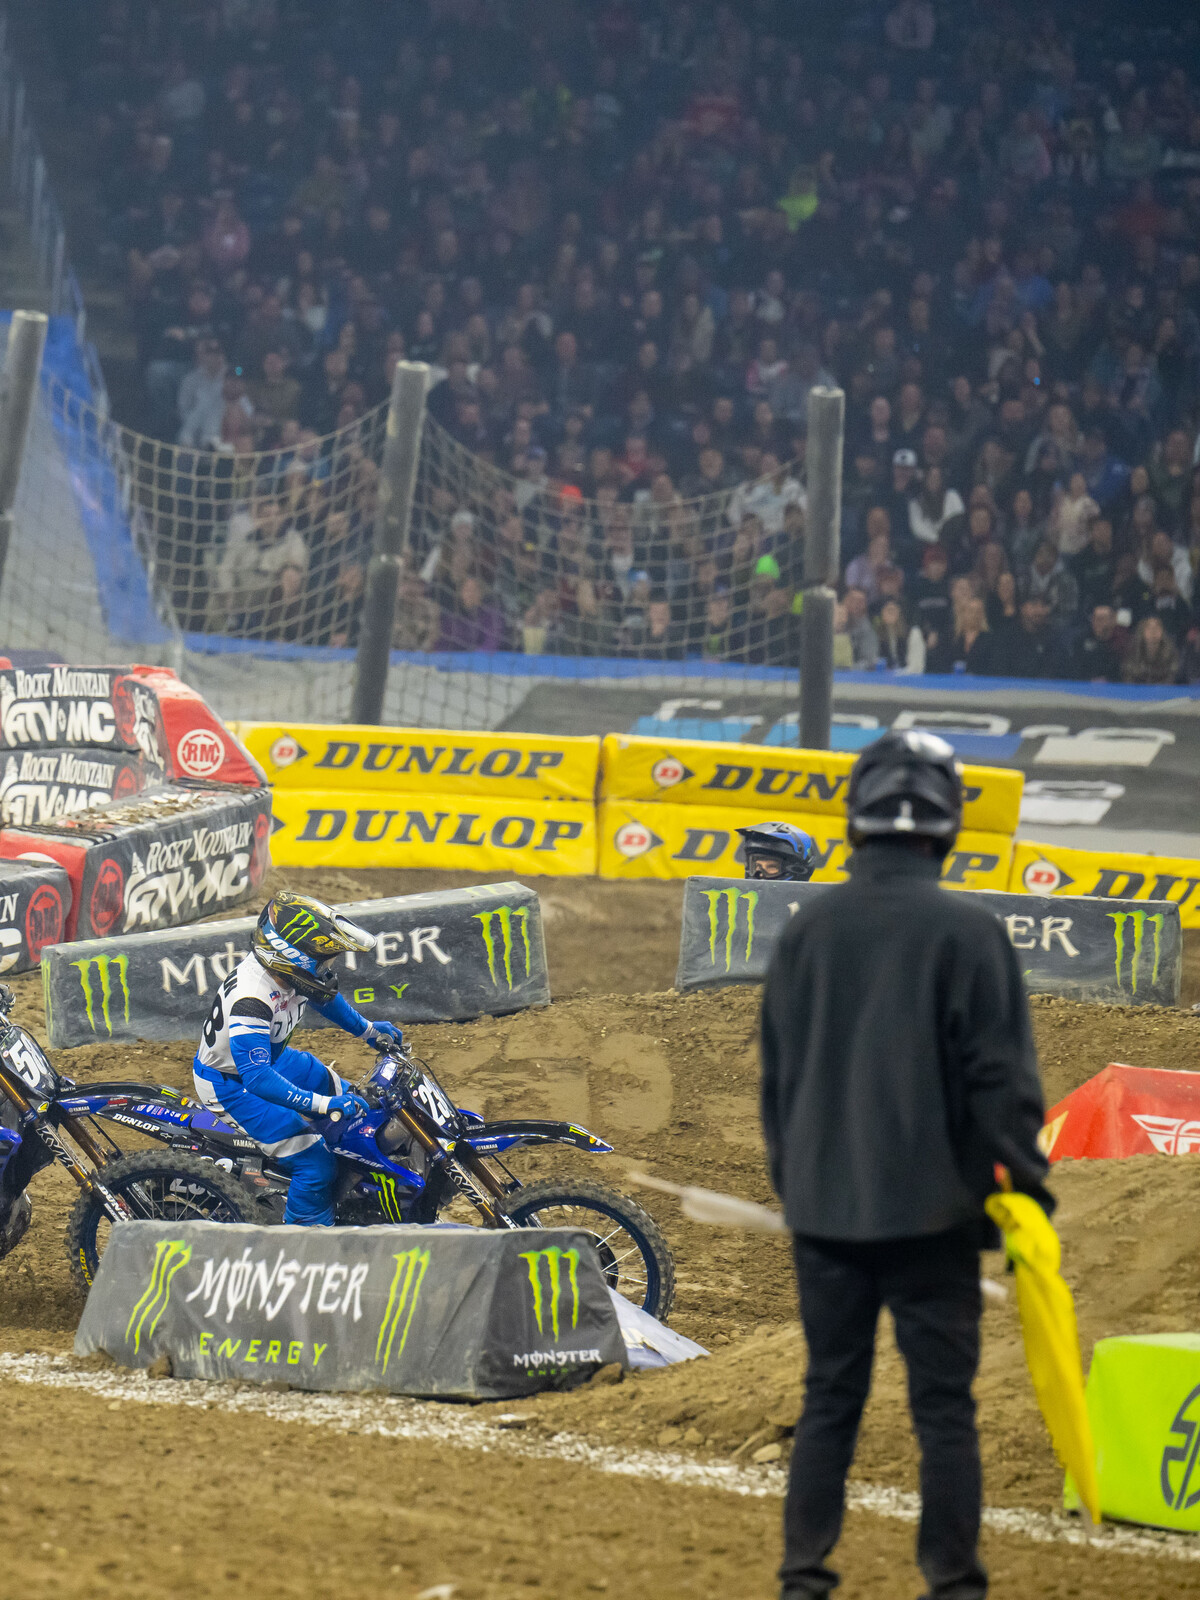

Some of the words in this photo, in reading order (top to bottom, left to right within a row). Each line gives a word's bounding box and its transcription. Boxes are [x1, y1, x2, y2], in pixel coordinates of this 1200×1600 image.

[16, 669, 50, 699] ROCKY
[52, 667, 110, 697] MOUNTAIN
[19, 752, 56, 781] ROCKY
[57, 753, 115, 788] MOUNTAIN
[188, 743, 215, 762] RM
[313, 741, 564, 779] DUNLOP
[295, 809, 584, 852] DUNLOP
[112, 1113, 160, 1132] DUNLOP
[233, 1139, 256, 1149] YAMAHA
[101, 1185, 130, 1222] DUNL
[79, 1248, 93, 1287] UNLOP
[186, 1246, 369, 1322] MONSTER
[198, 1332, 328, 1367] ENERGY
[513, 1349, 602, 1369] MONSTER
